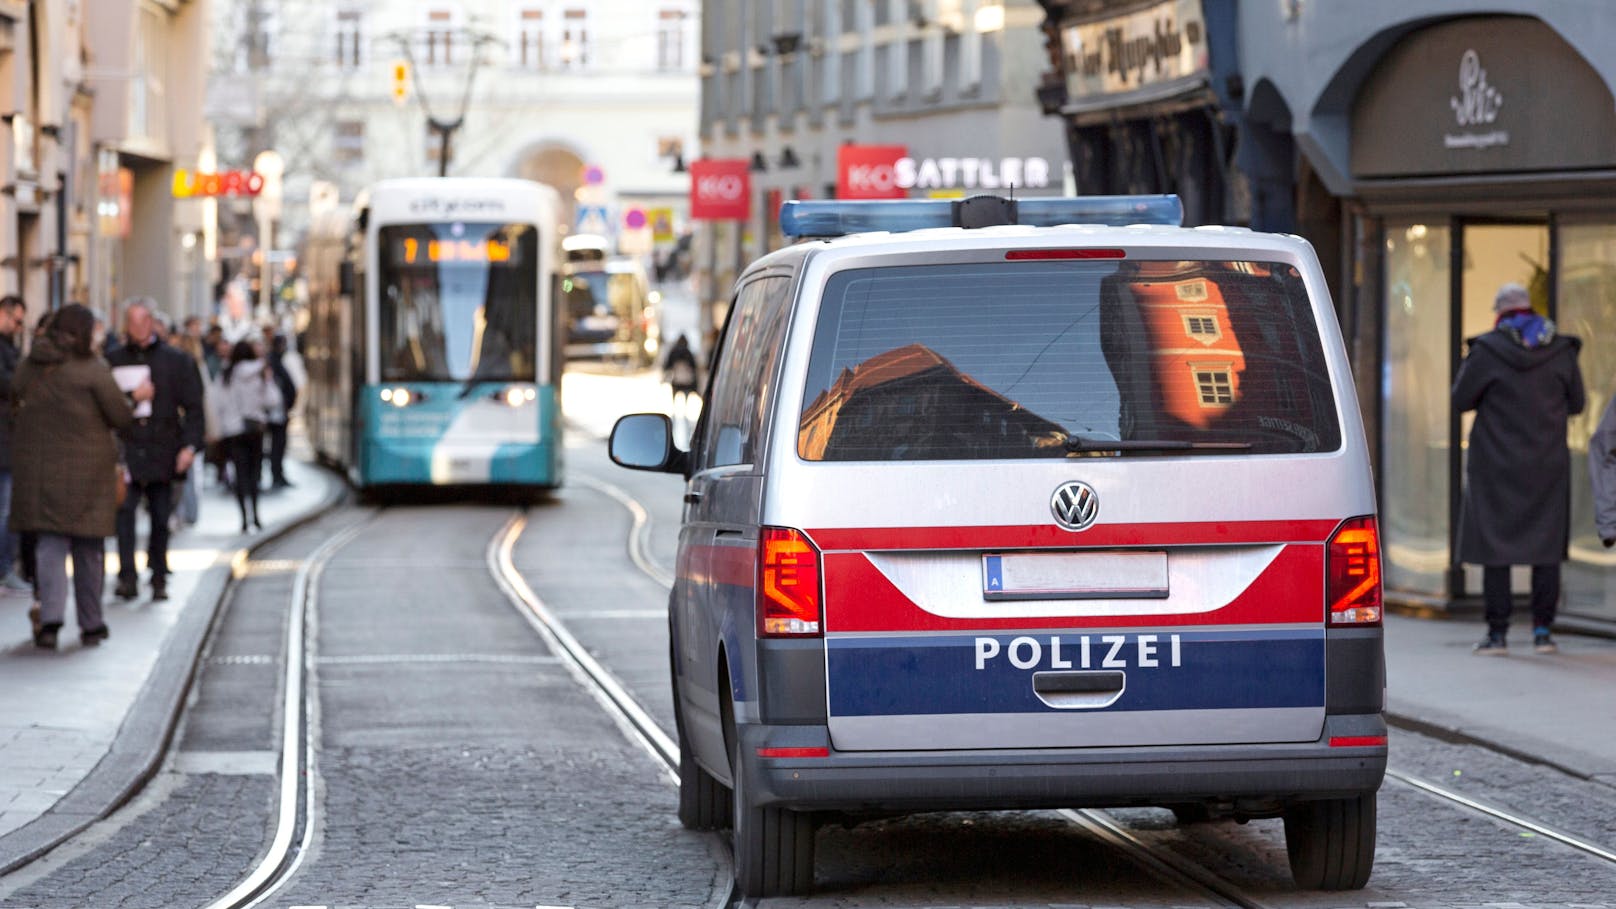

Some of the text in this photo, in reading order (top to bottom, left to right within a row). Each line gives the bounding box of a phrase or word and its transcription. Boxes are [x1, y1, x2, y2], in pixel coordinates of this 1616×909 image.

[895, 157, 1049, 189] SATTLER
[991, 577, 999, 586] A
[975, 634, 1181, 669] POLIZEI
